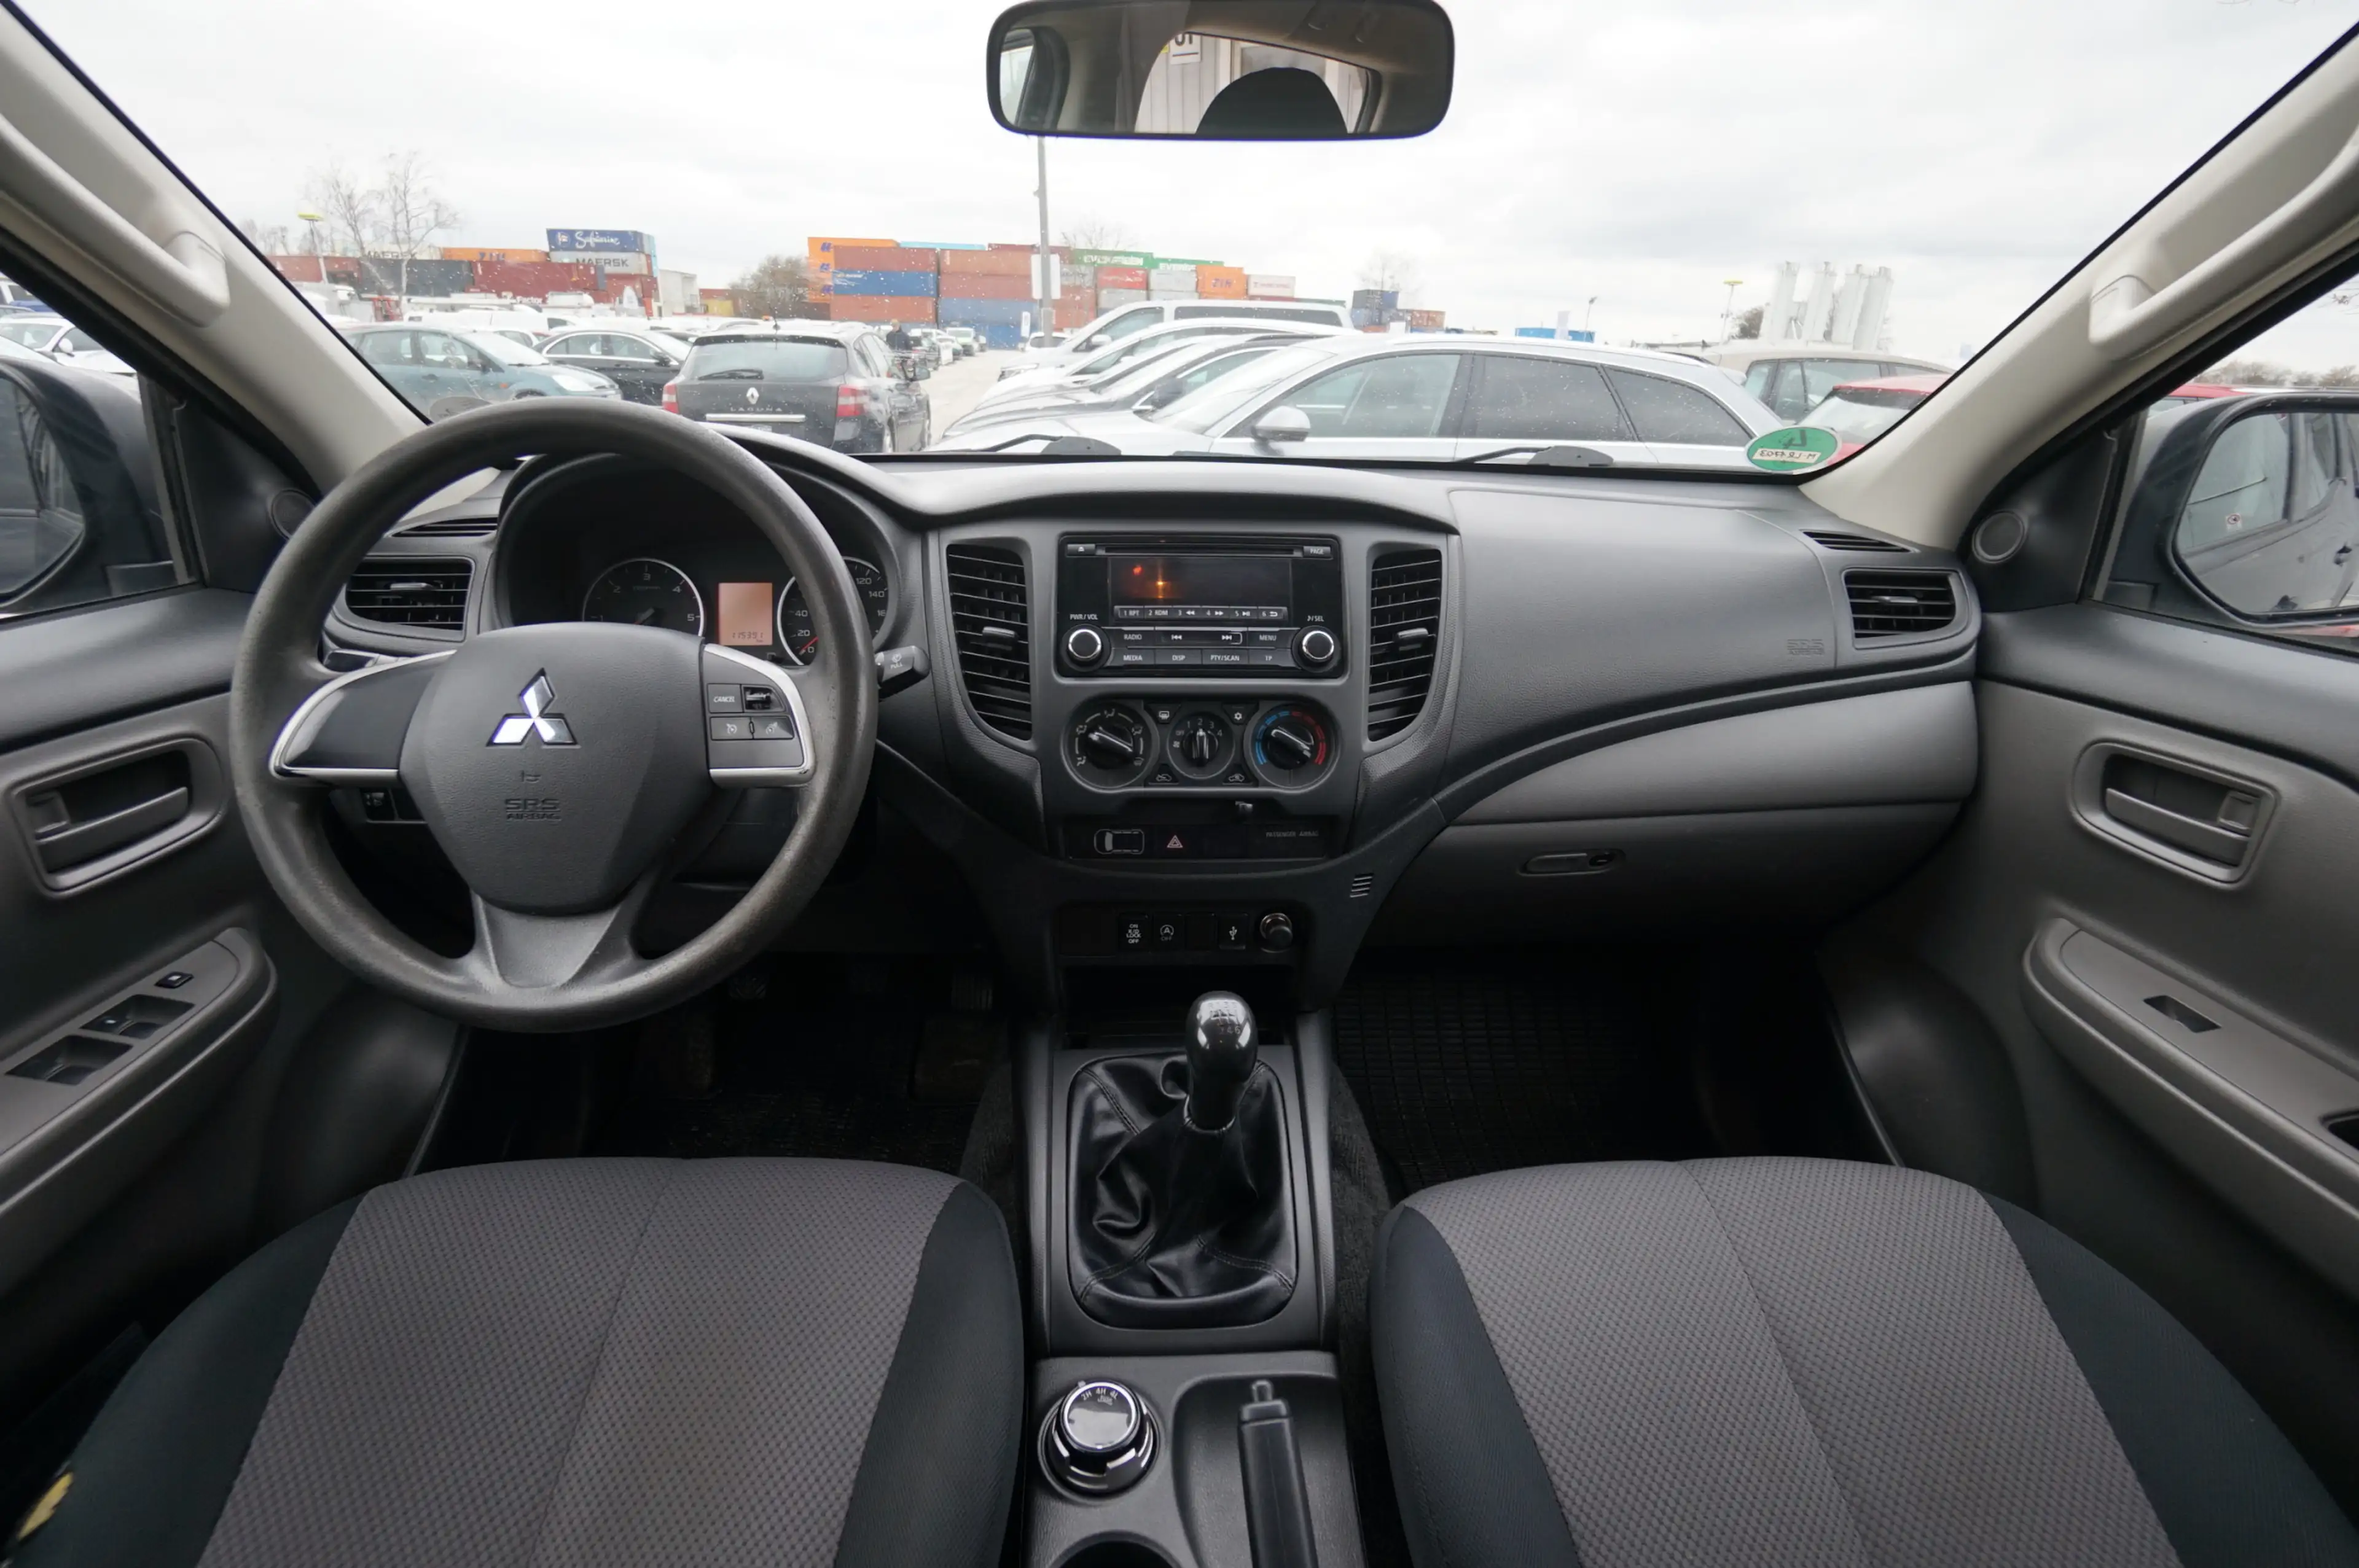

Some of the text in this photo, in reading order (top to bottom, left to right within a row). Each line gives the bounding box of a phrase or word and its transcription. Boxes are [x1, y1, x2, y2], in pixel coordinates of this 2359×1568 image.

[1187, 720, 1191, 729] 1
[1210, 720, 1215, 729] 3
[505, 798, 560, 810] SRS
[506, 813, 561, 822] AIRBAG
[1235, 1026, 1241, 1034] 6
[1081, 1390, 1092, 1401] 2H
